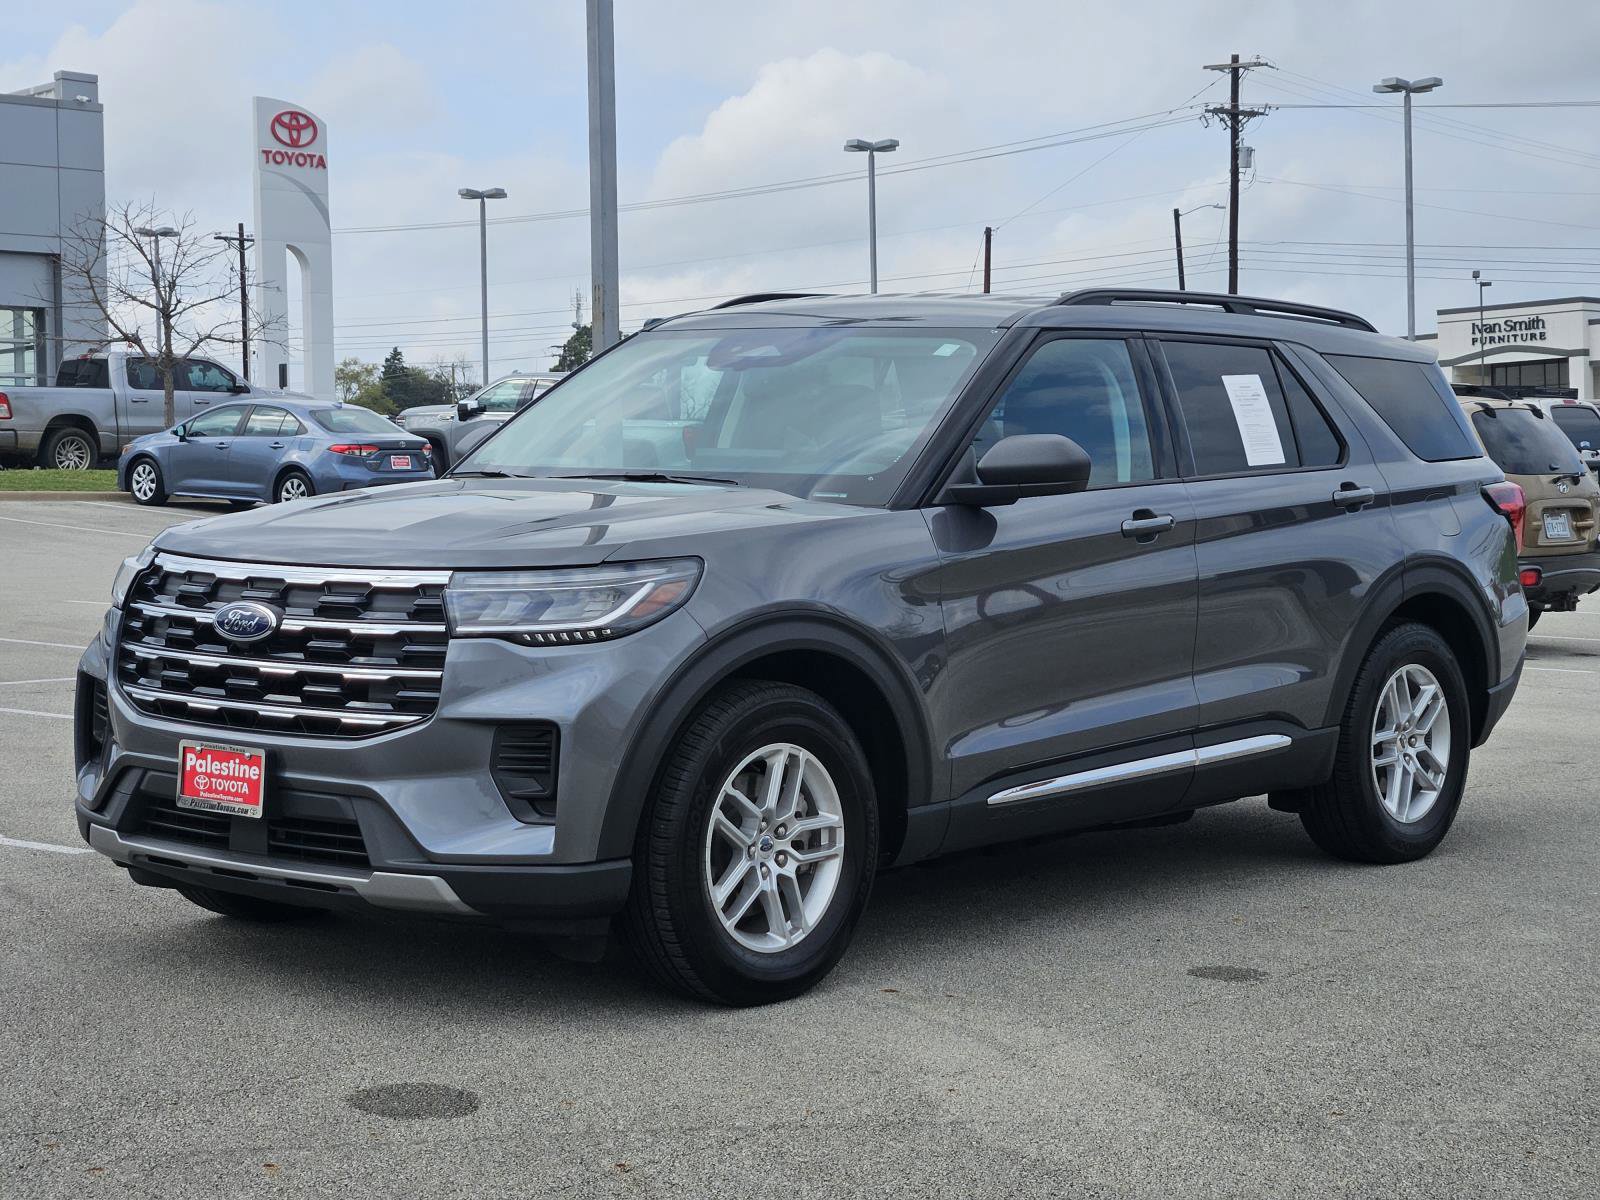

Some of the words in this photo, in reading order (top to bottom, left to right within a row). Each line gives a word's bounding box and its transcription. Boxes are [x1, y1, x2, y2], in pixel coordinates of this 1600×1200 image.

[261, 149, 327, 169] TOYOTA
[1471, 322, 1502, 335] Ivan
[1503, 315, 1546, 333] Smith
[1471, 331, 1547, 346] FURNITURE
[223, 609, 260, 632] Ford
[185, 752, 260, 780] Palestine
[210, 778, 249, 795] TOYOTA
